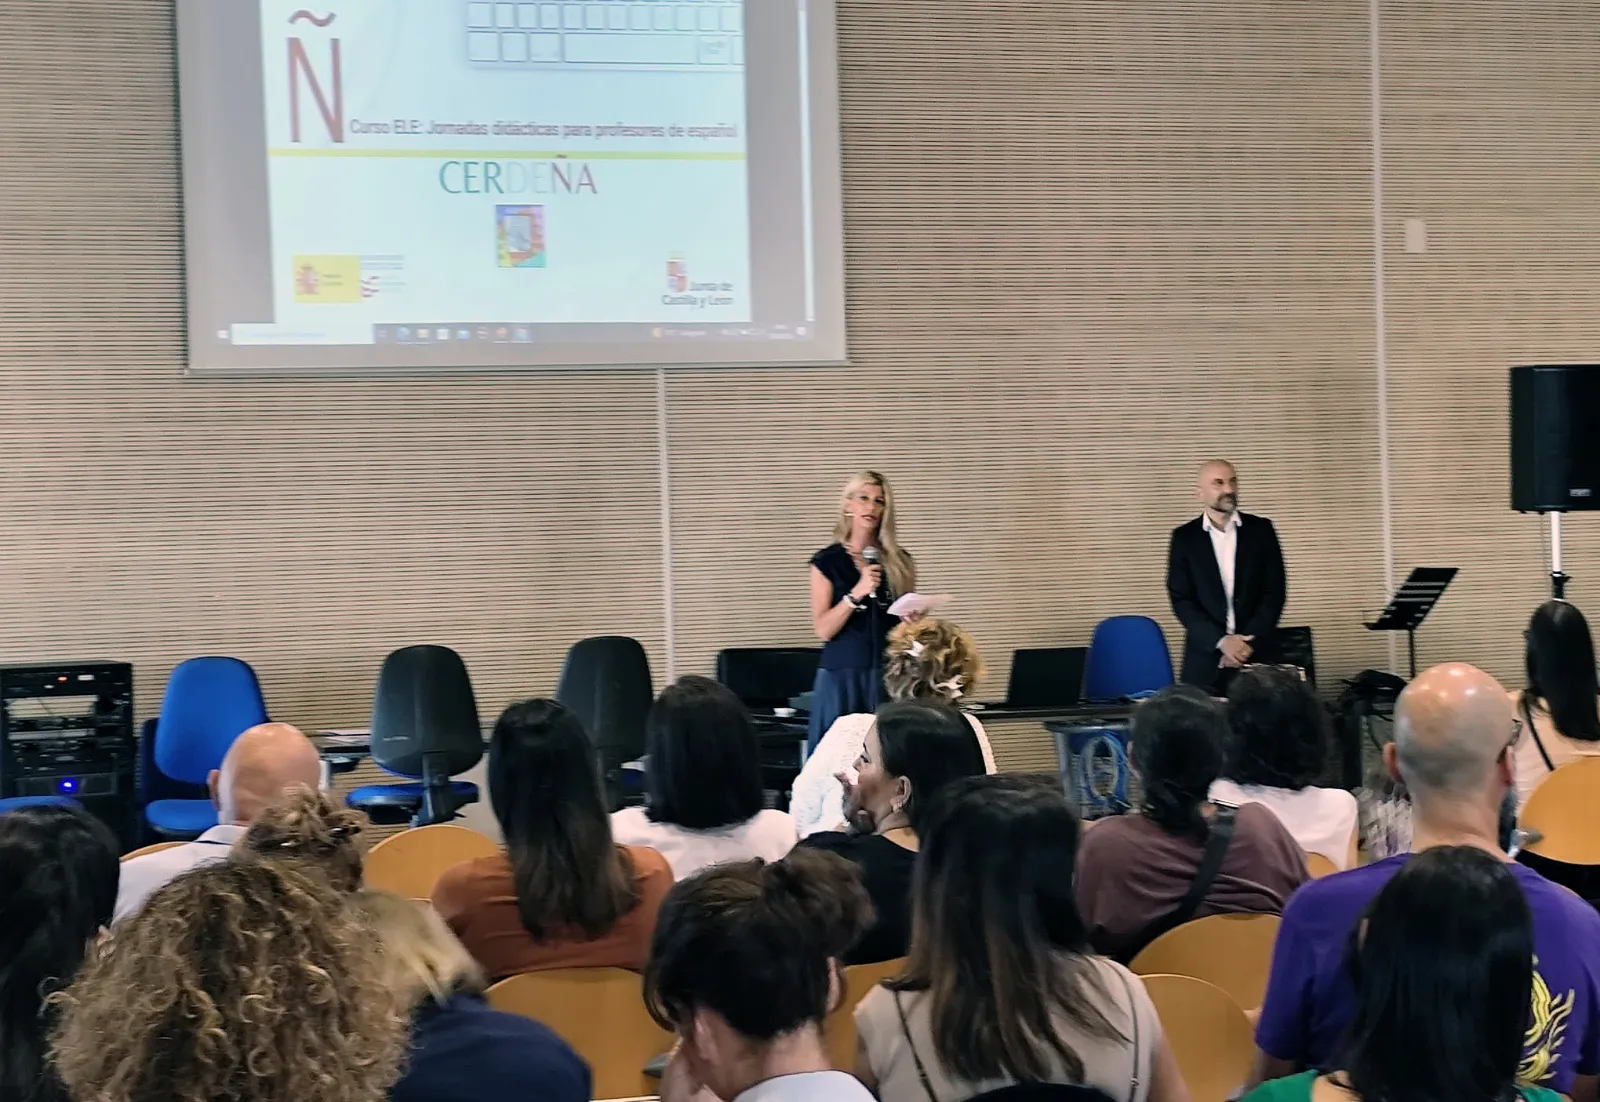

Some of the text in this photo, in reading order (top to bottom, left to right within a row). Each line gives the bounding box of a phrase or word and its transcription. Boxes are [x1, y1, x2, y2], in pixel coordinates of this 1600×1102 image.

[287, 9, 344, 143] Ñ
[350, 119, 390, 135] Curso
[427, 120, 489, 136] Jornadas
[492, 120, 559, 136] didácticas
[563, 124, 592, 140] para
[595, 121, 665, 140] profesores
[668, 123, 685, 138] de
[688, 122, 738, 141] español
[438, 154, 598, 194] CERDEÑA
[689, 280, 734, 292] Junta de
